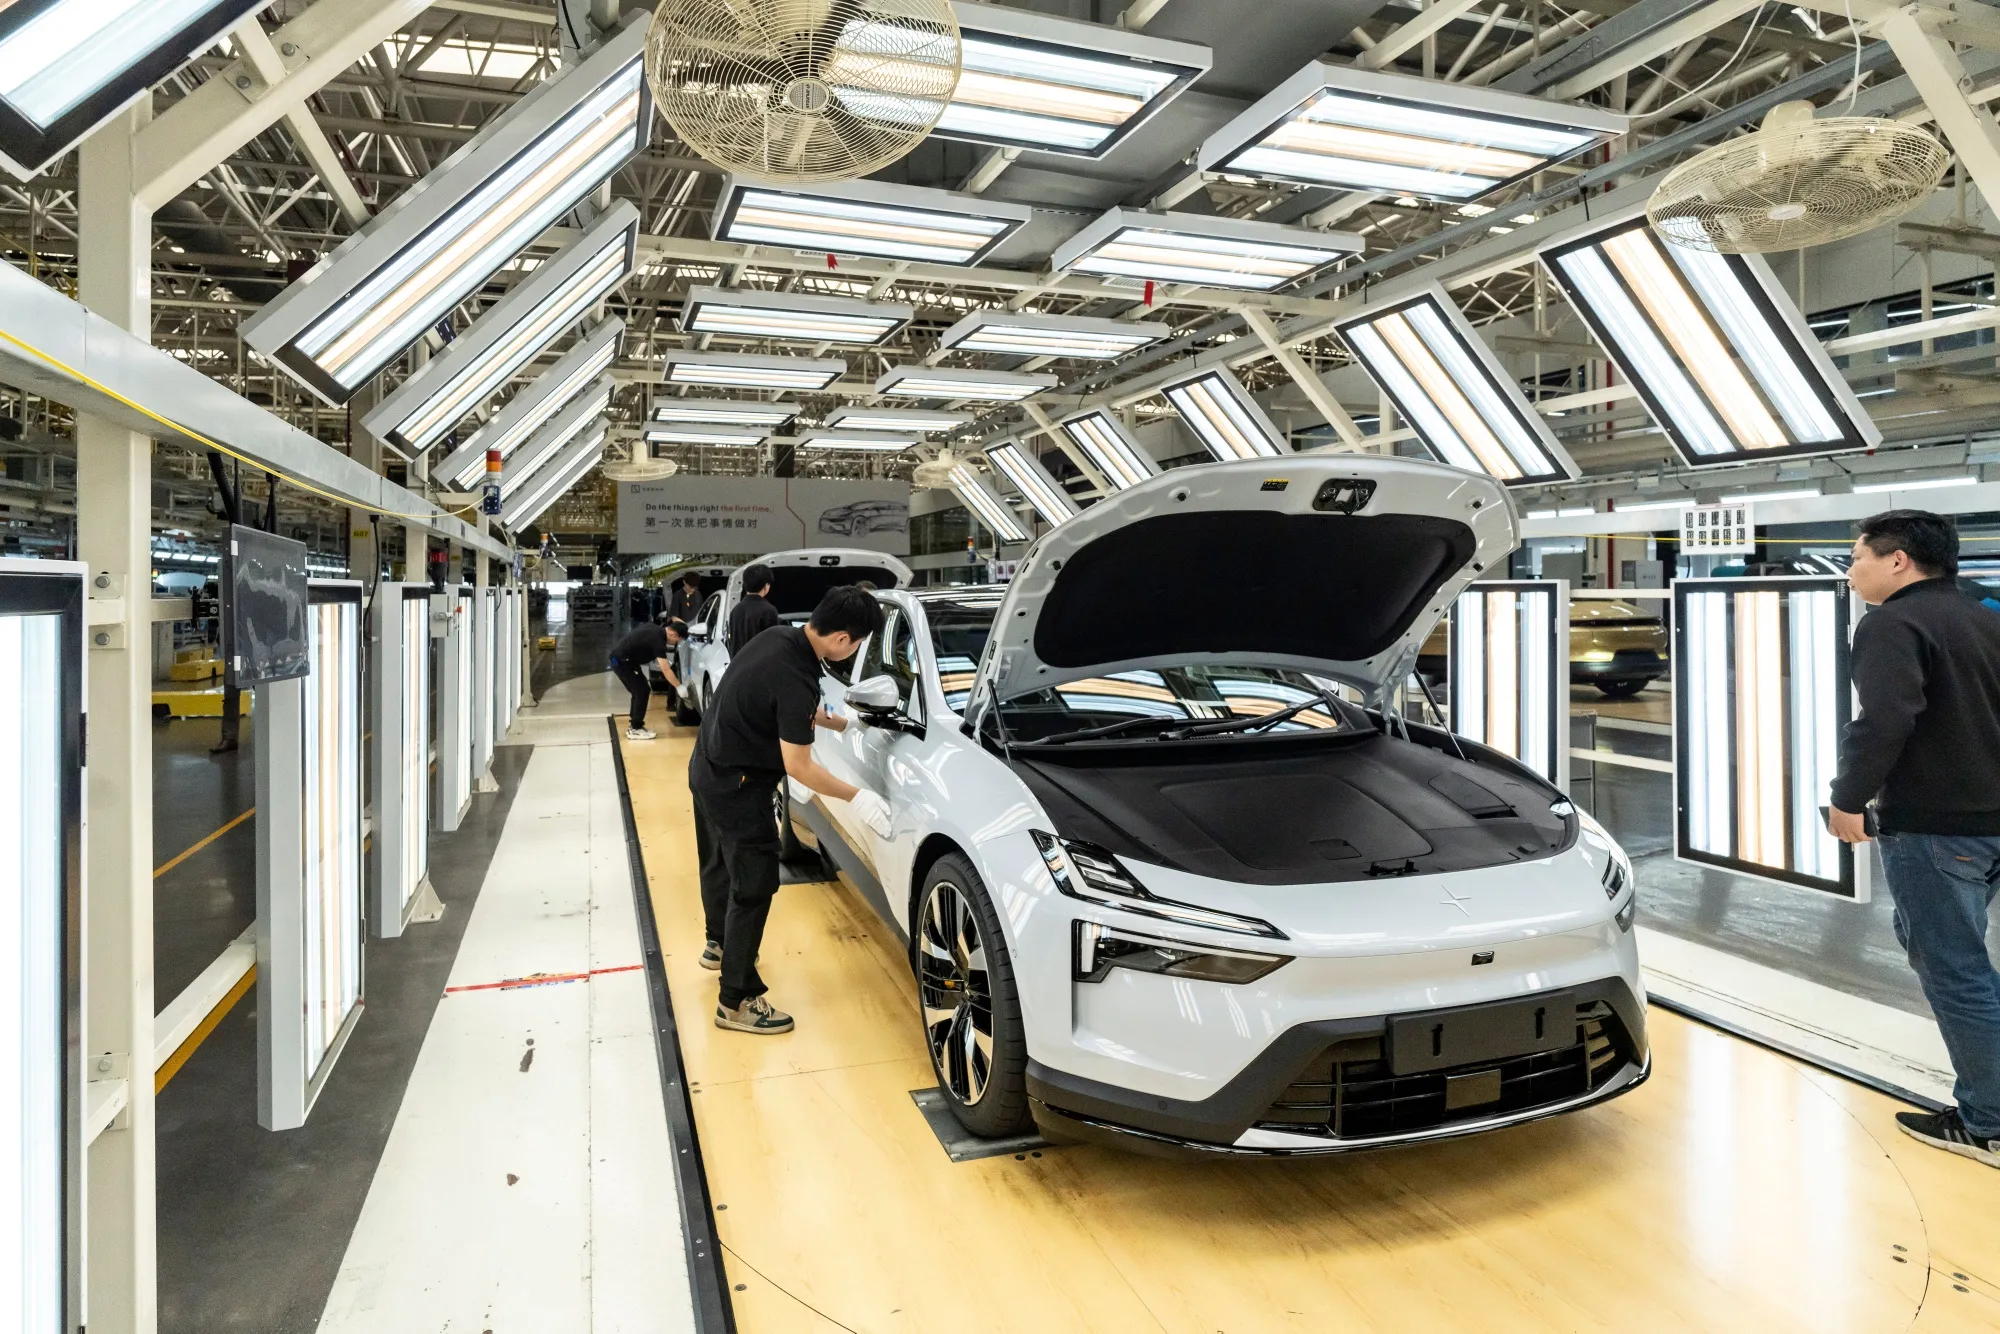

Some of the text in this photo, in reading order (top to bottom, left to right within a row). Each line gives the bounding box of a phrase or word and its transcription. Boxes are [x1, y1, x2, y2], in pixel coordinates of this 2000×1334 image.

[645, 503, 657, 511] Do
[673, 504, 698, 513] things
[700, 505, 719, 513] right
[645, 517, 758, 529] 第一次就把事情做对
